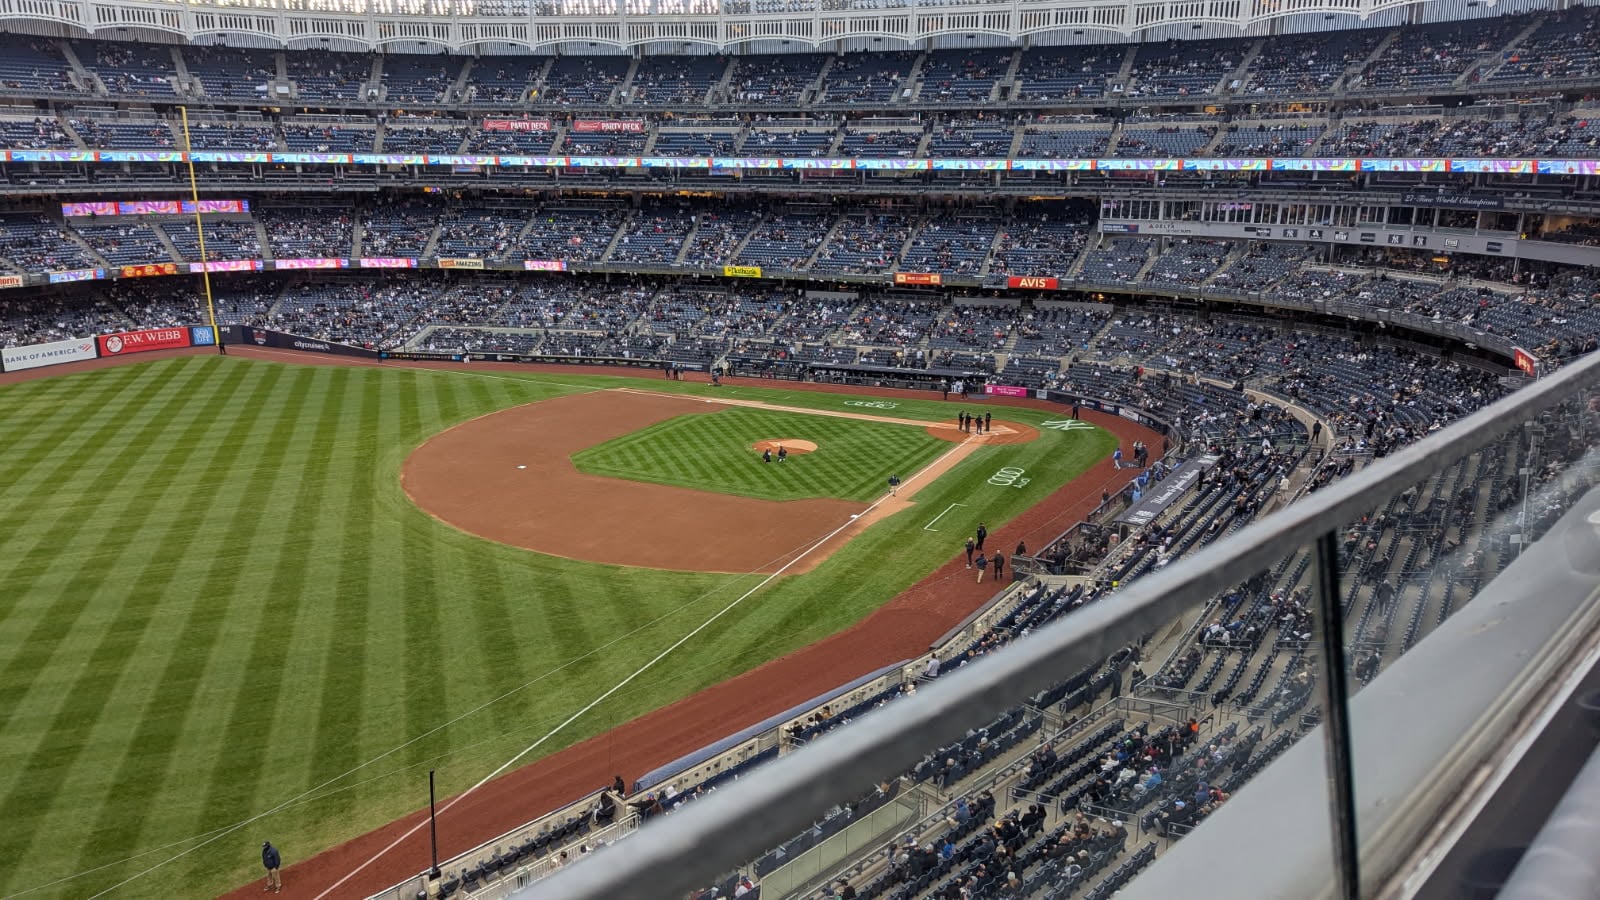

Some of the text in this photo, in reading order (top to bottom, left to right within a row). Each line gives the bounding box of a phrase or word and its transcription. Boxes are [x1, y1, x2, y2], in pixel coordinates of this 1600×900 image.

[510, 121, 530, 130] PARTY
[531, 121, 548, 130] DECK
[602, 122, 621, 131] PARTY
[622, 122, 640, 131] DECK
[1436, 196, 1458, 204] World
[1459, 197, 1498, 207] Champions
[1019, 277, 1046, 287] AVIS
[123, 333, 145, 345] F.W.
[145, 330, 181, 341] WEBB
[5, 348, 78, 364] BANK OF AMERICA
